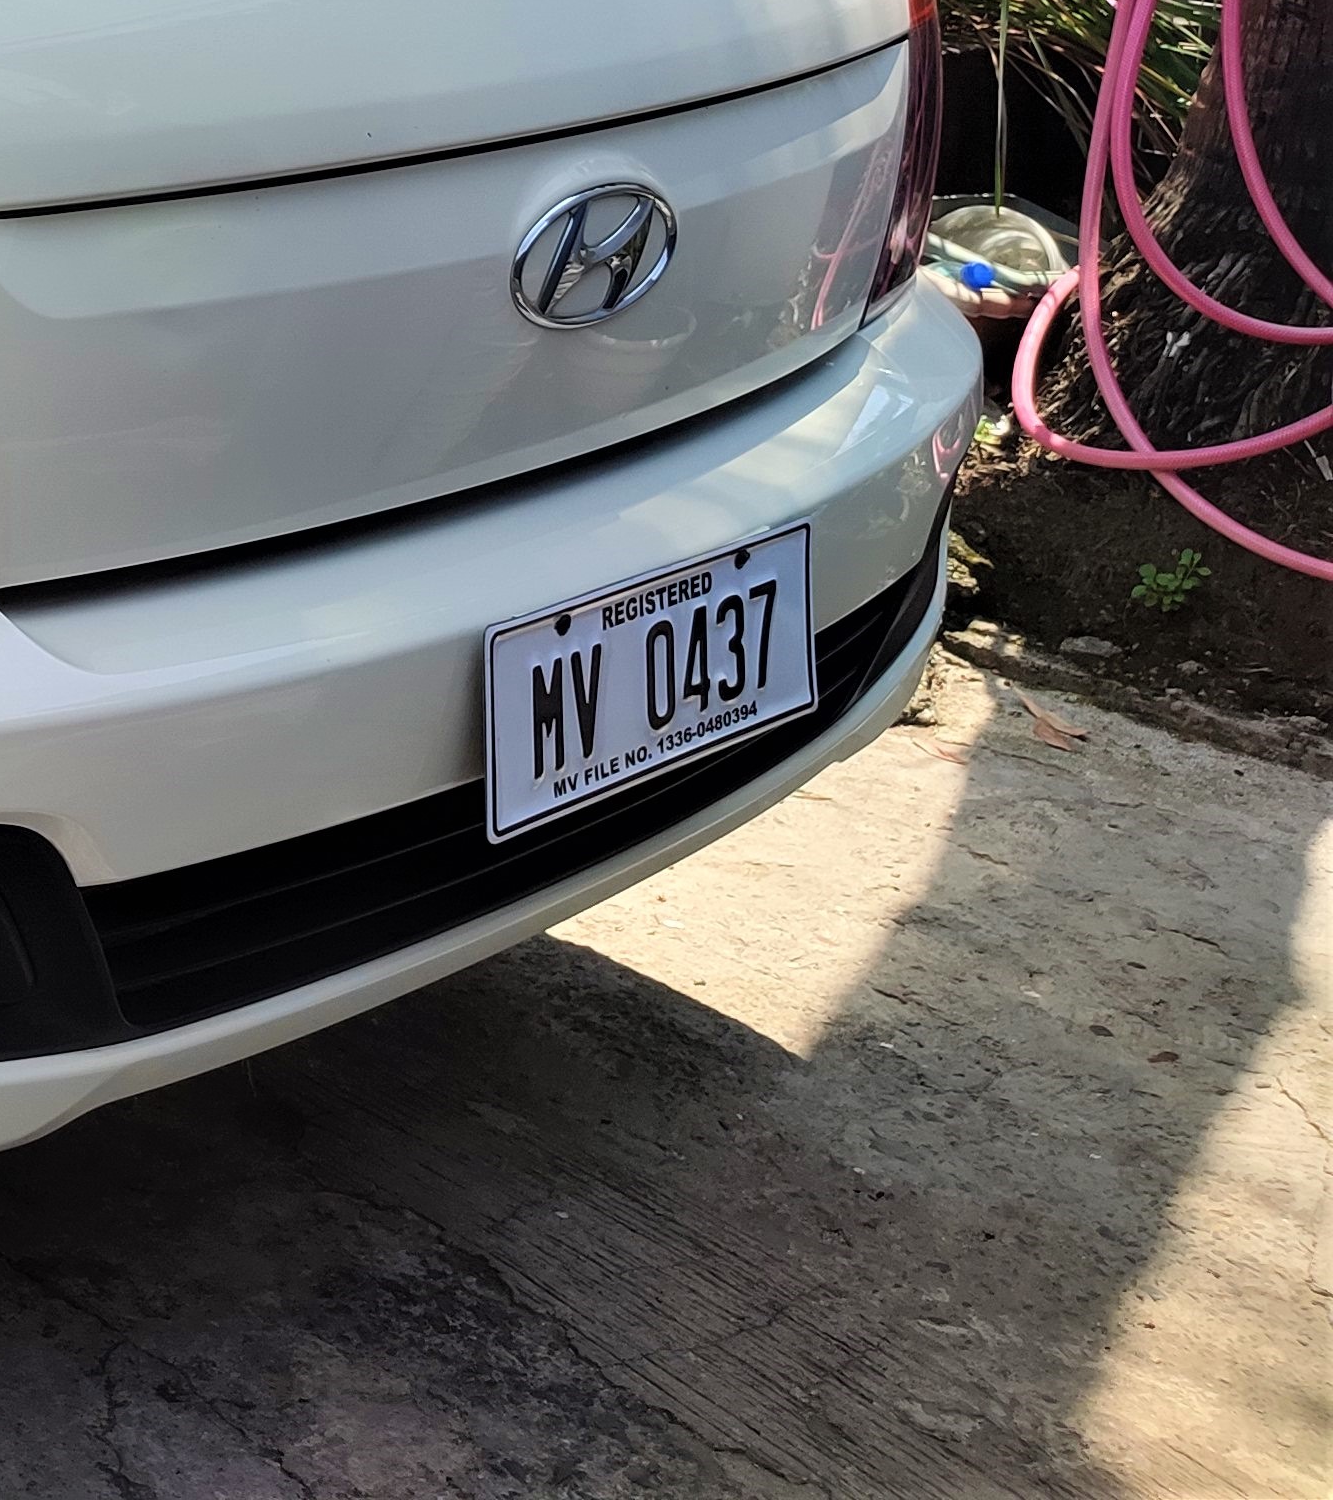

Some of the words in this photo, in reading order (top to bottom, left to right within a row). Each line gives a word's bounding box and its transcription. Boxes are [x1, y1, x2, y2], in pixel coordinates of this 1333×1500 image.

[602, 572, 712, 631] REGISTERED
[532, 643, 602, 780] MV
[646, 579, 777, 730] 0437
[553, 773, 578, 798] MV
[584, 757, 619, 785] FILE
[624, 747, 652, 767] NO.
[656, 701, 758, 754] 1336-0480394
